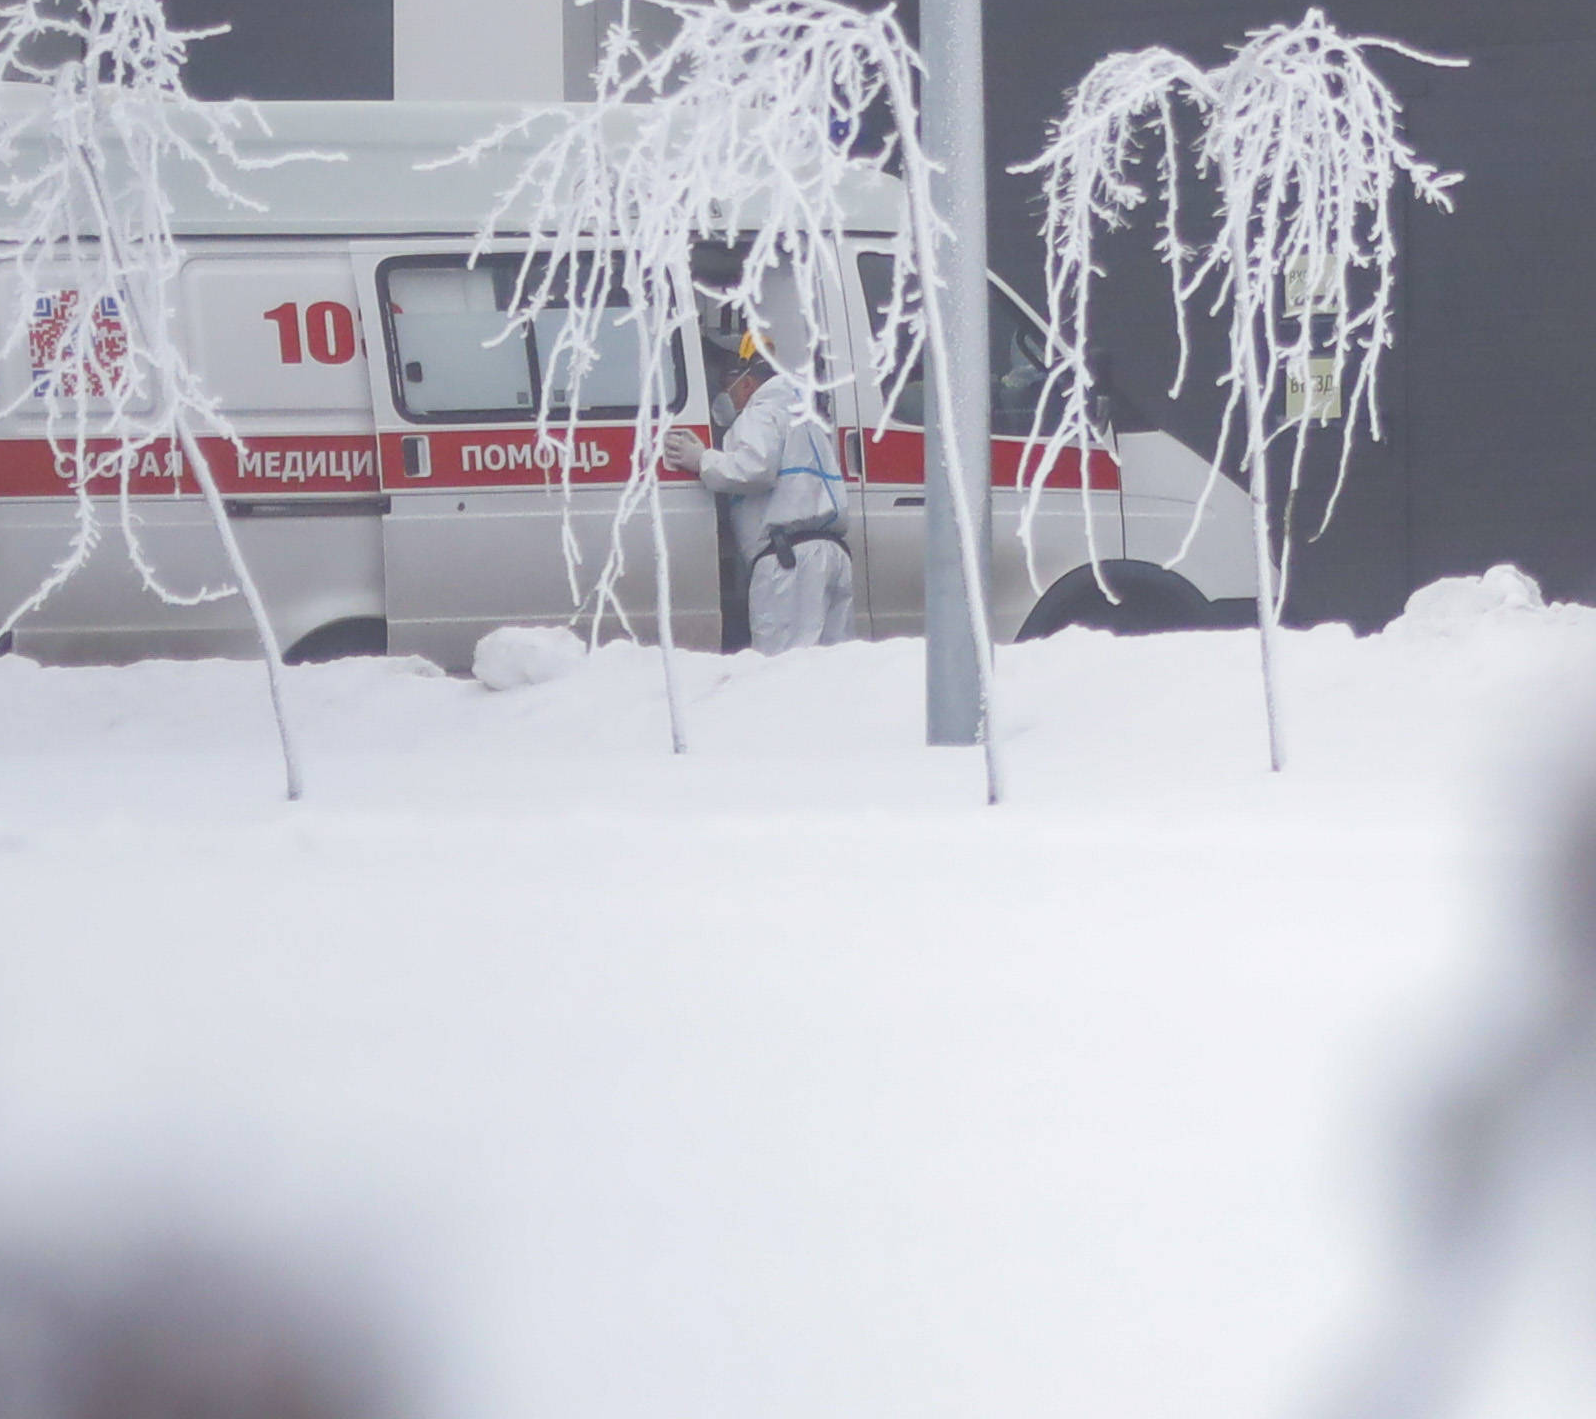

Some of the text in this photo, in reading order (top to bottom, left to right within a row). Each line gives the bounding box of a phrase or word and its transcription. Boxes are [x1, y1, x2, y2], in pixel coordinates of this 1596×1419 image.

[262, 299, 367, 365] 10
[236, 449, 379, 483] МЕДИЦИ
[460, 441, 611, 474] ПОМОЩЬ
